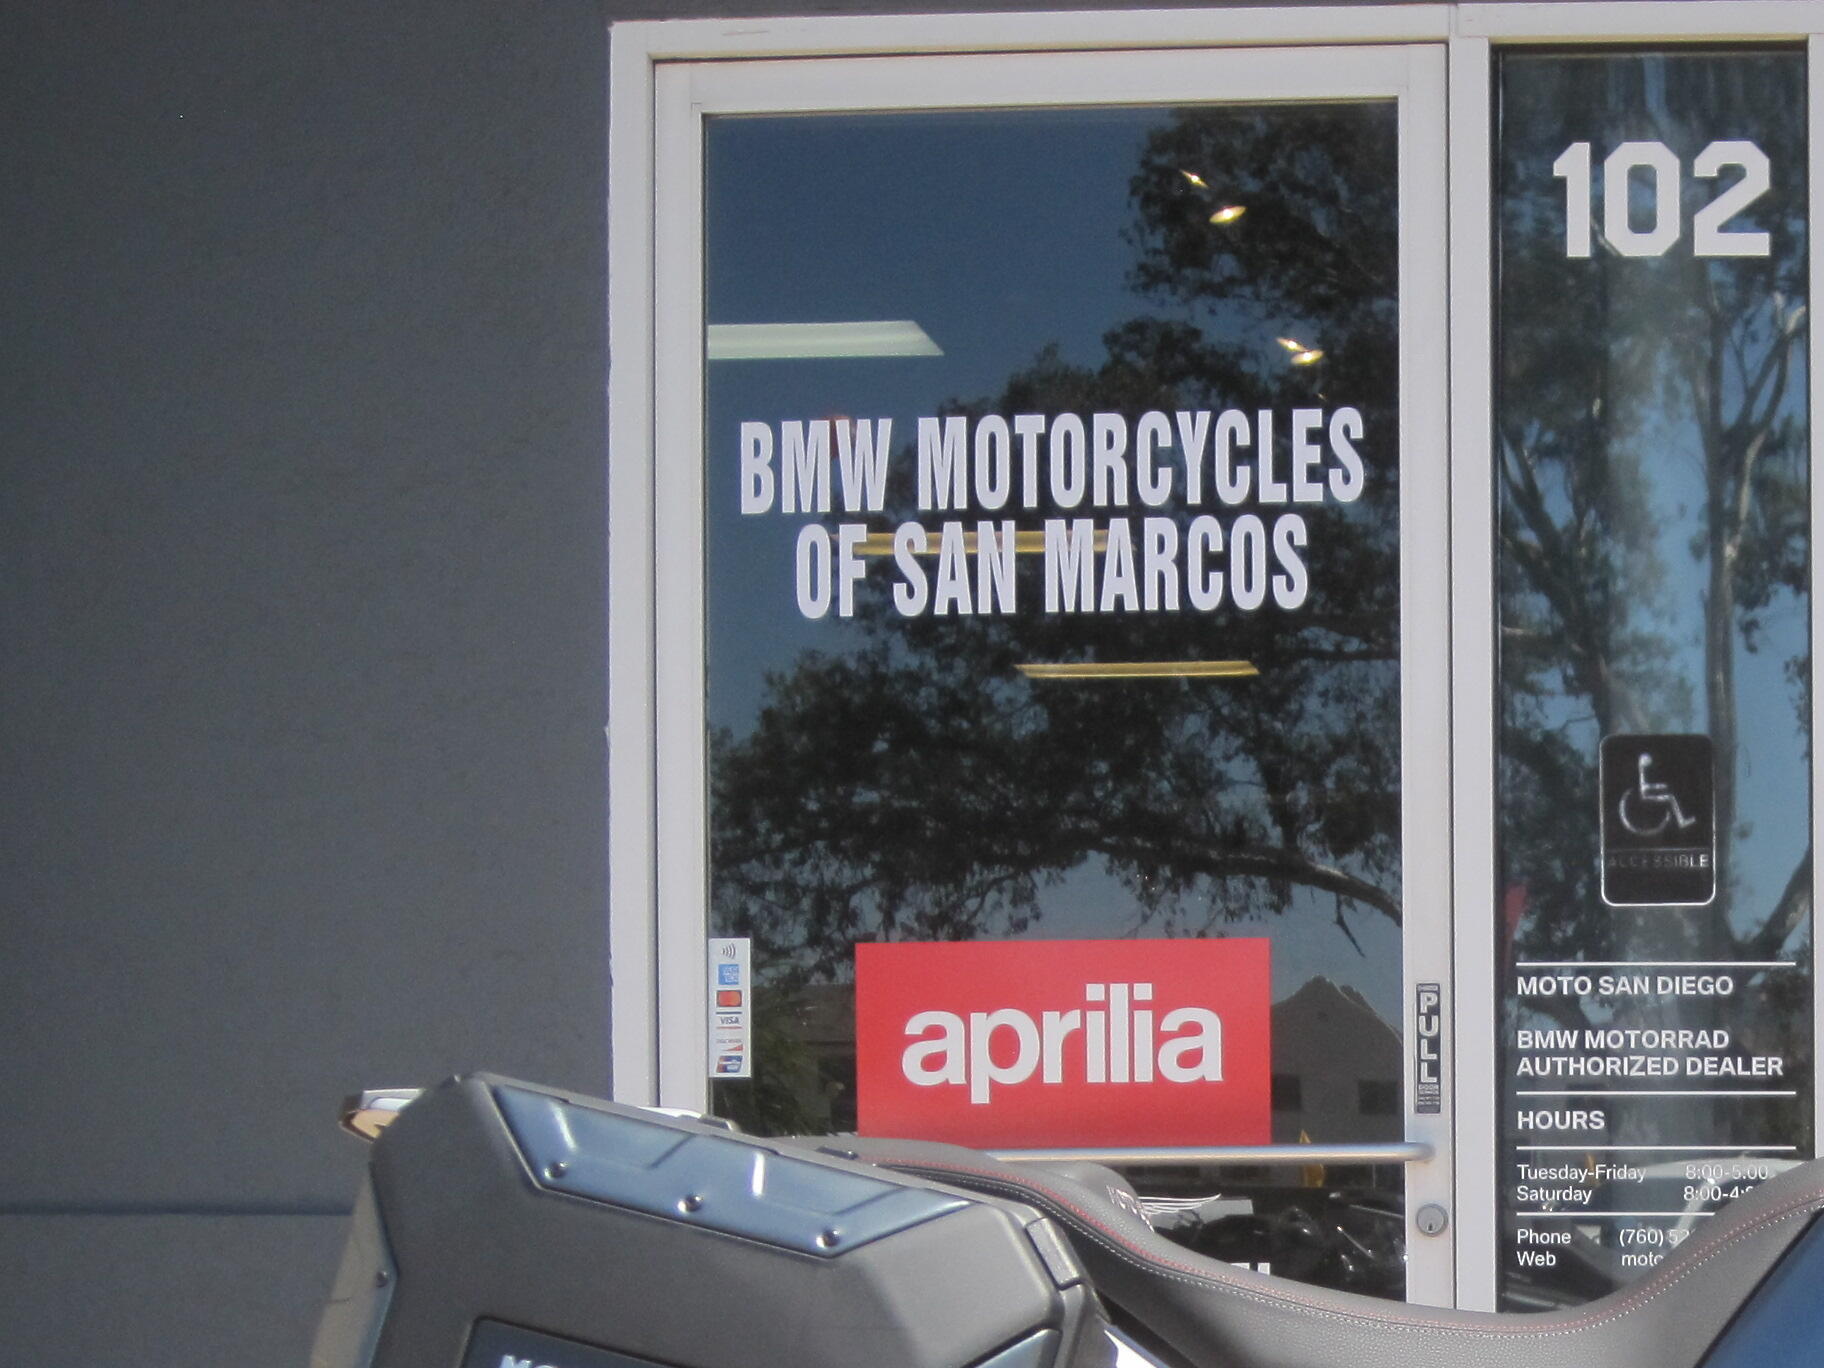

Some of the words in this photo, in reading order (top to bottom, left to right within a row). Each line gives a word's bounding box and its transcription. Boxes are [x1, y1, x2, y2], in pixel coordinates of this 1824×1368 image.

[1553, 140, 1770, 257] 102
[740, 417, 892, 515] BMW
[917, 407, 1365, 511] MOTORCYCLES
[797, 522, 868, 619] OF
[892, 518, 1017, 616] SAN
[1045, 513, 1309, 614] MARCOS
[1516, 976, 1592, 996] MOTO
[1598, 976, 1650, 996] SAN
[1656, 976, 1734, 996] DIEGO
[719, 1016, 740, 1025] VISA
[901, 983, 1224, 1105] aprilia
[1418, 991, 1439, 1083] PULL
[1516, 1030, 1577, 1049] BMW
[1584, 1030, 1730, 1049] MOTORRAD
[1516, 1056, 1679, 1076] AUTHORIZED
[1685, 1056, 1784, 1076] DEALER
[1516, 1110, 1605, 1130] HOURS
[1516, 1164, 1647, 1183] Tuesday-Friday
[1516, 1185, 1593, 1204] Saturday
[1516, 1228, 1572, 1245] Phone
[1619, 1228, 1664, 1247] (760)
[1516, 1251, 1557, 1266] Web
